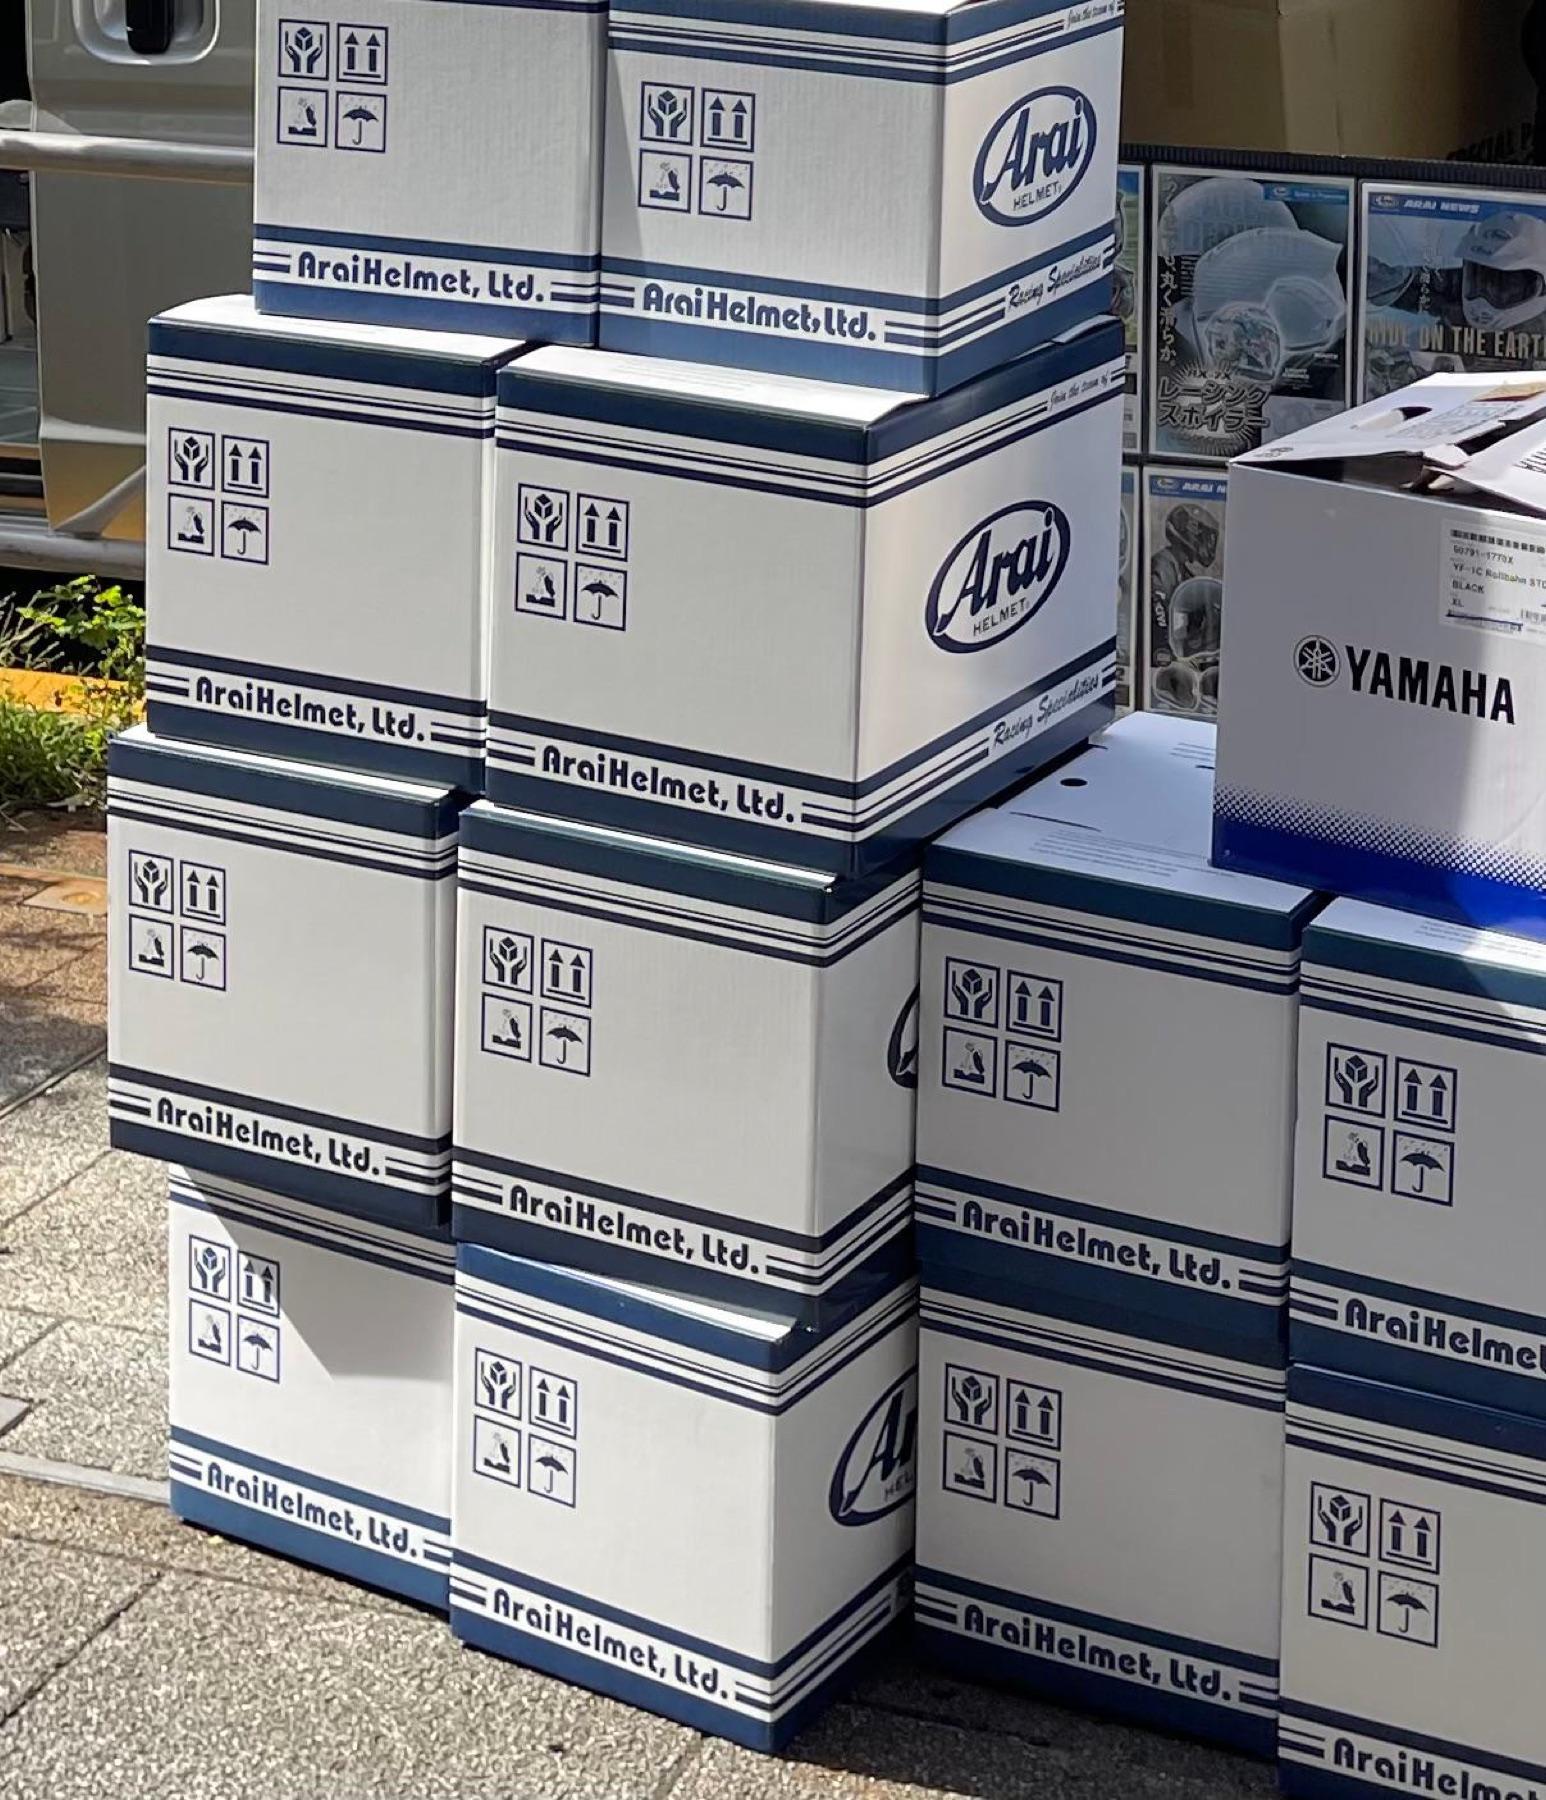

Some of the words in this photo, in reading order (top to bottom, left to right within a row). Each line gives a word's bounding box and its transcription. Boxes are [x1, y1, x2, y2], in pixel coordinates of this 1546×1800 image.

[979, 96, 1084, 202] Arai
[488, 270, 544, 302] Ltd.
[1419, 325, 1444, 351] ON
[1453, 327, 1486, 356] THE
[935, 507, 1055, 634] Arai
[1452, 580, 1485, 594] BLACK
[972, 598, 1027, 637] HELMET
[1344, 644, 1516, 725] YAMAHA
[372, 707, 425, 742] Ltd.
[736, 783, 794, 823] Ltd.
[328, 1138, 381, 1176] Ltd.
[702, 1233, 759, 1274] Ltd.
[1168, 1247, 1231, 1289] Ltd.
[842, 1389, 918, 1514] Ar
[368, 1516, 418, 1558] Ltd.
[673, 1653, 728, 1699] Ltd.
[1169, 1658, 1231, 1701] Ltd.
